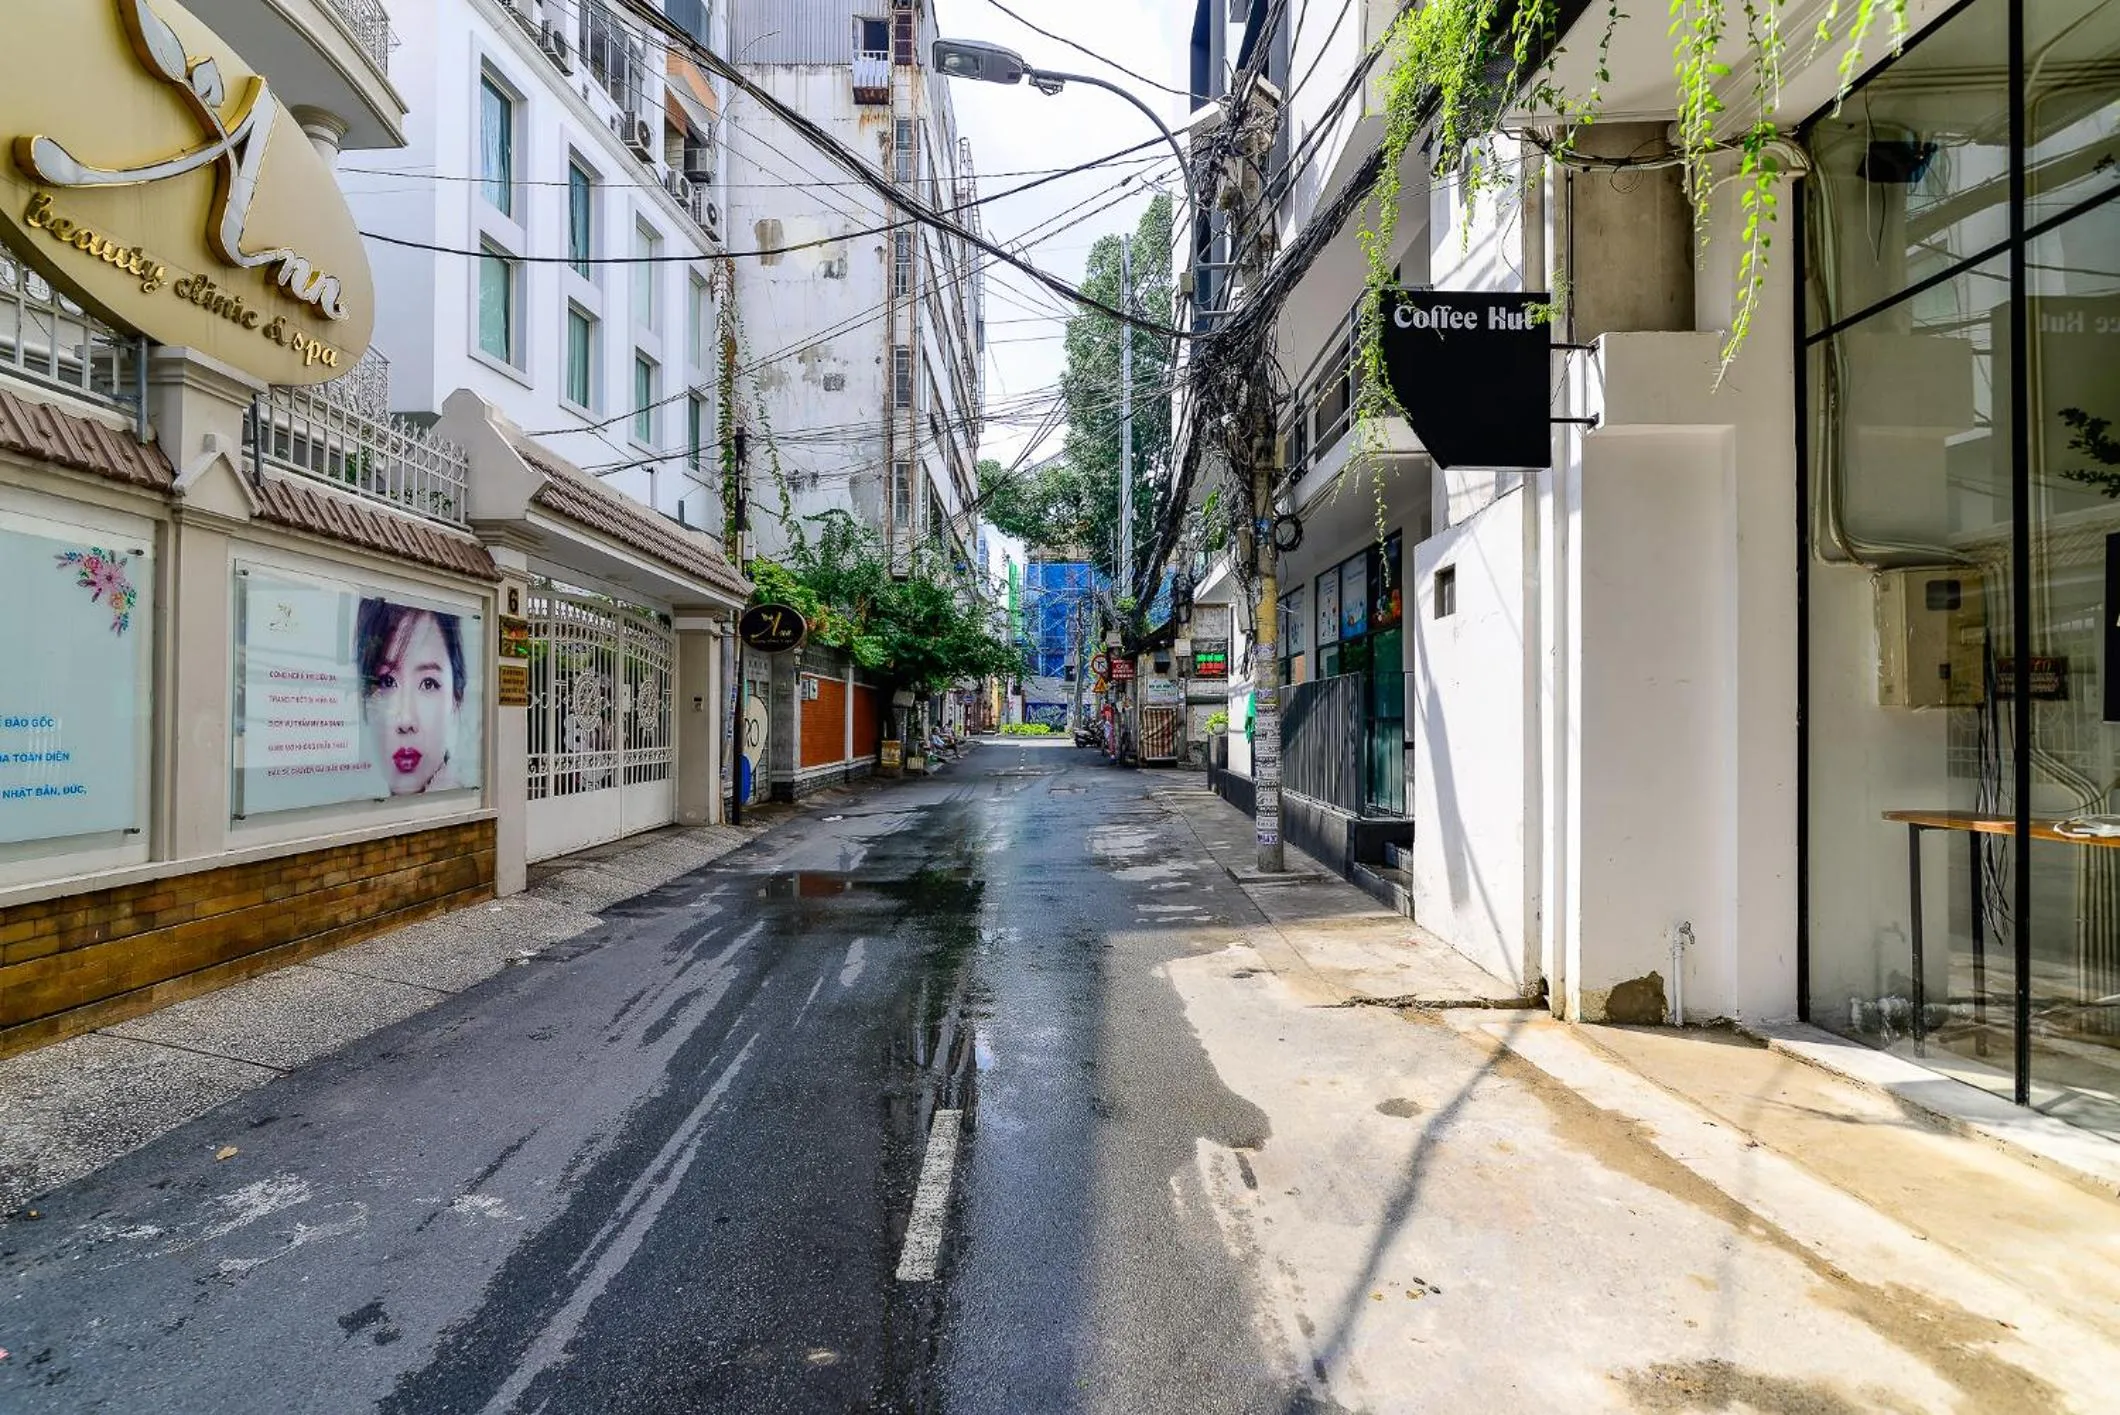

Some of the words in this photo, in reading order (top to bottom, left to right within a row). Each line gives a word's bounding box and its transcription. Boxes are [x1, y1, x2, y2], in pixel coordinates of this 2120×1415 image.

[24, 191, 168, 294] beauty
[174, 272, 260, 330] clinic
[292, 331, 339, 368] spa
[1394, 304, 1478, 329] Coffee
[508, 588, 519, 613] 6
